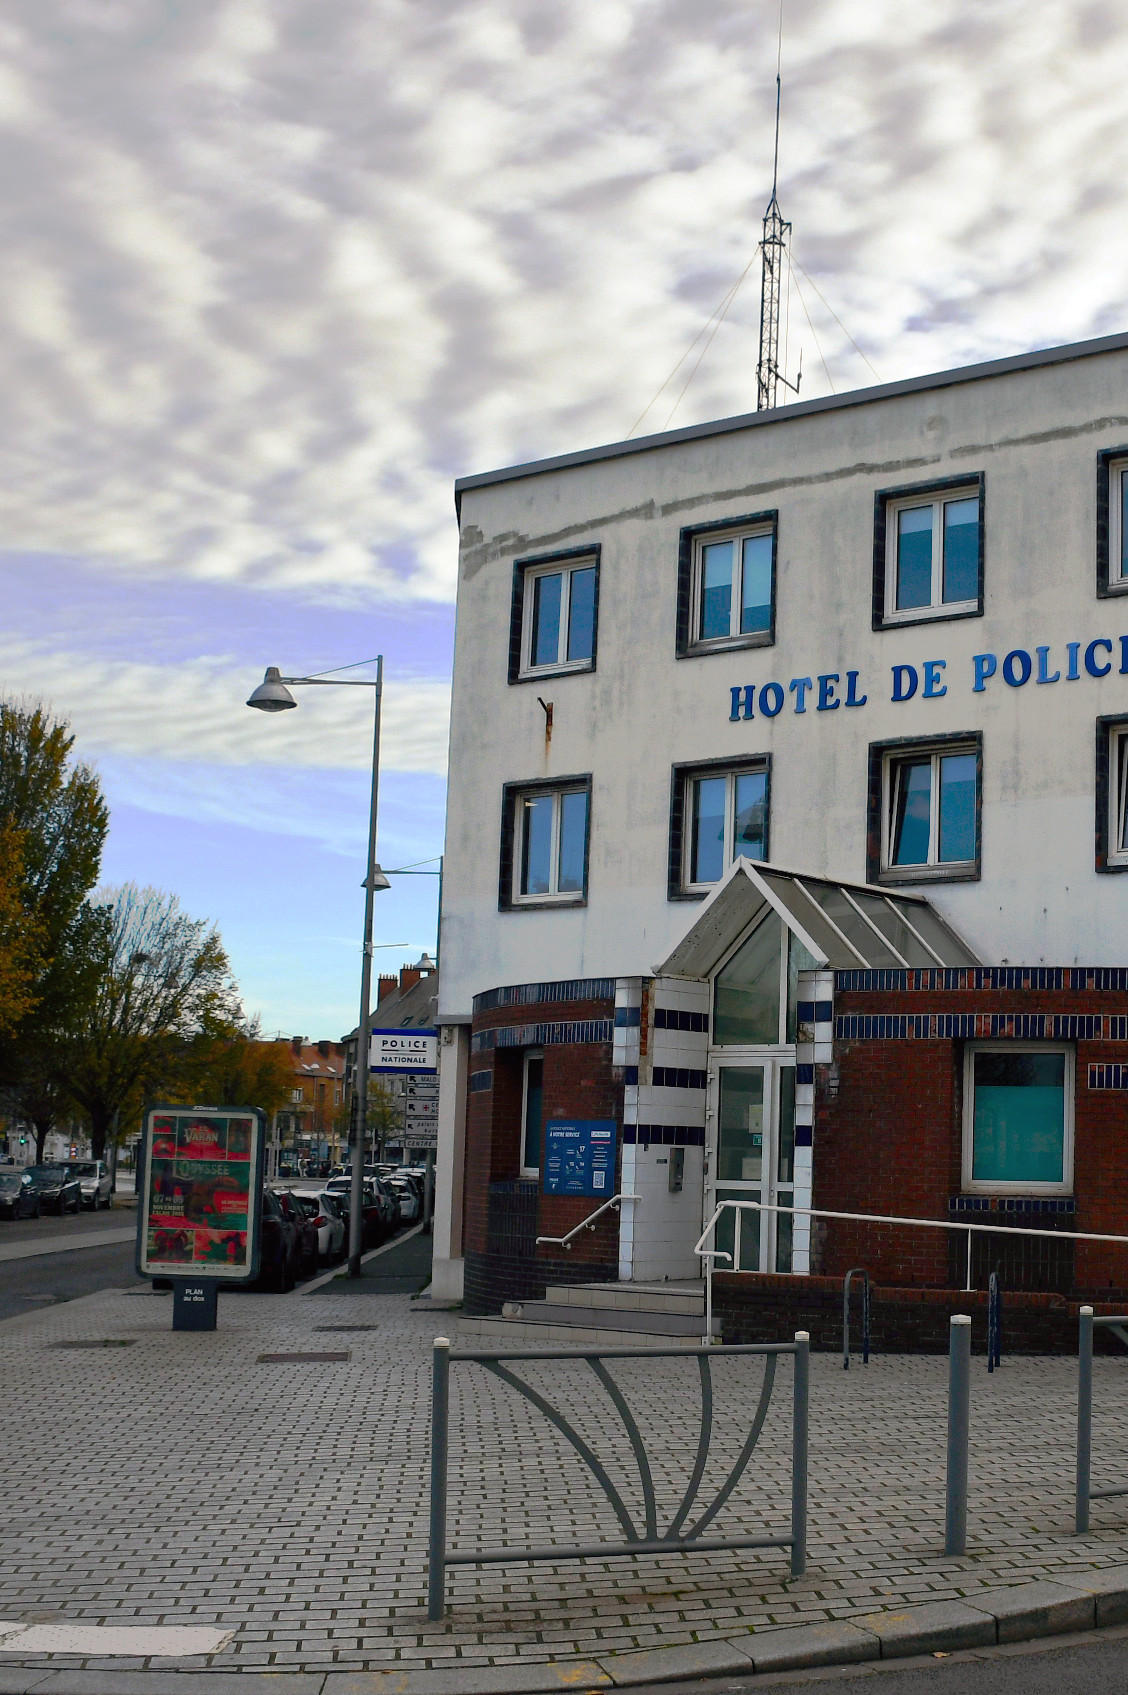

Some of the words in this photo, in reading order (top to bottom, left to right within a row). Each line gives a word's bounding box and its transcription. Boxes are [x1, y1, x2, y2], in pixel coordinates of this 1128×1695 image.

[729, 671, 867, 721] HOTEL
[891, 660, 948, 702] DE
[382, 1040, 427, 1048] POLICE
